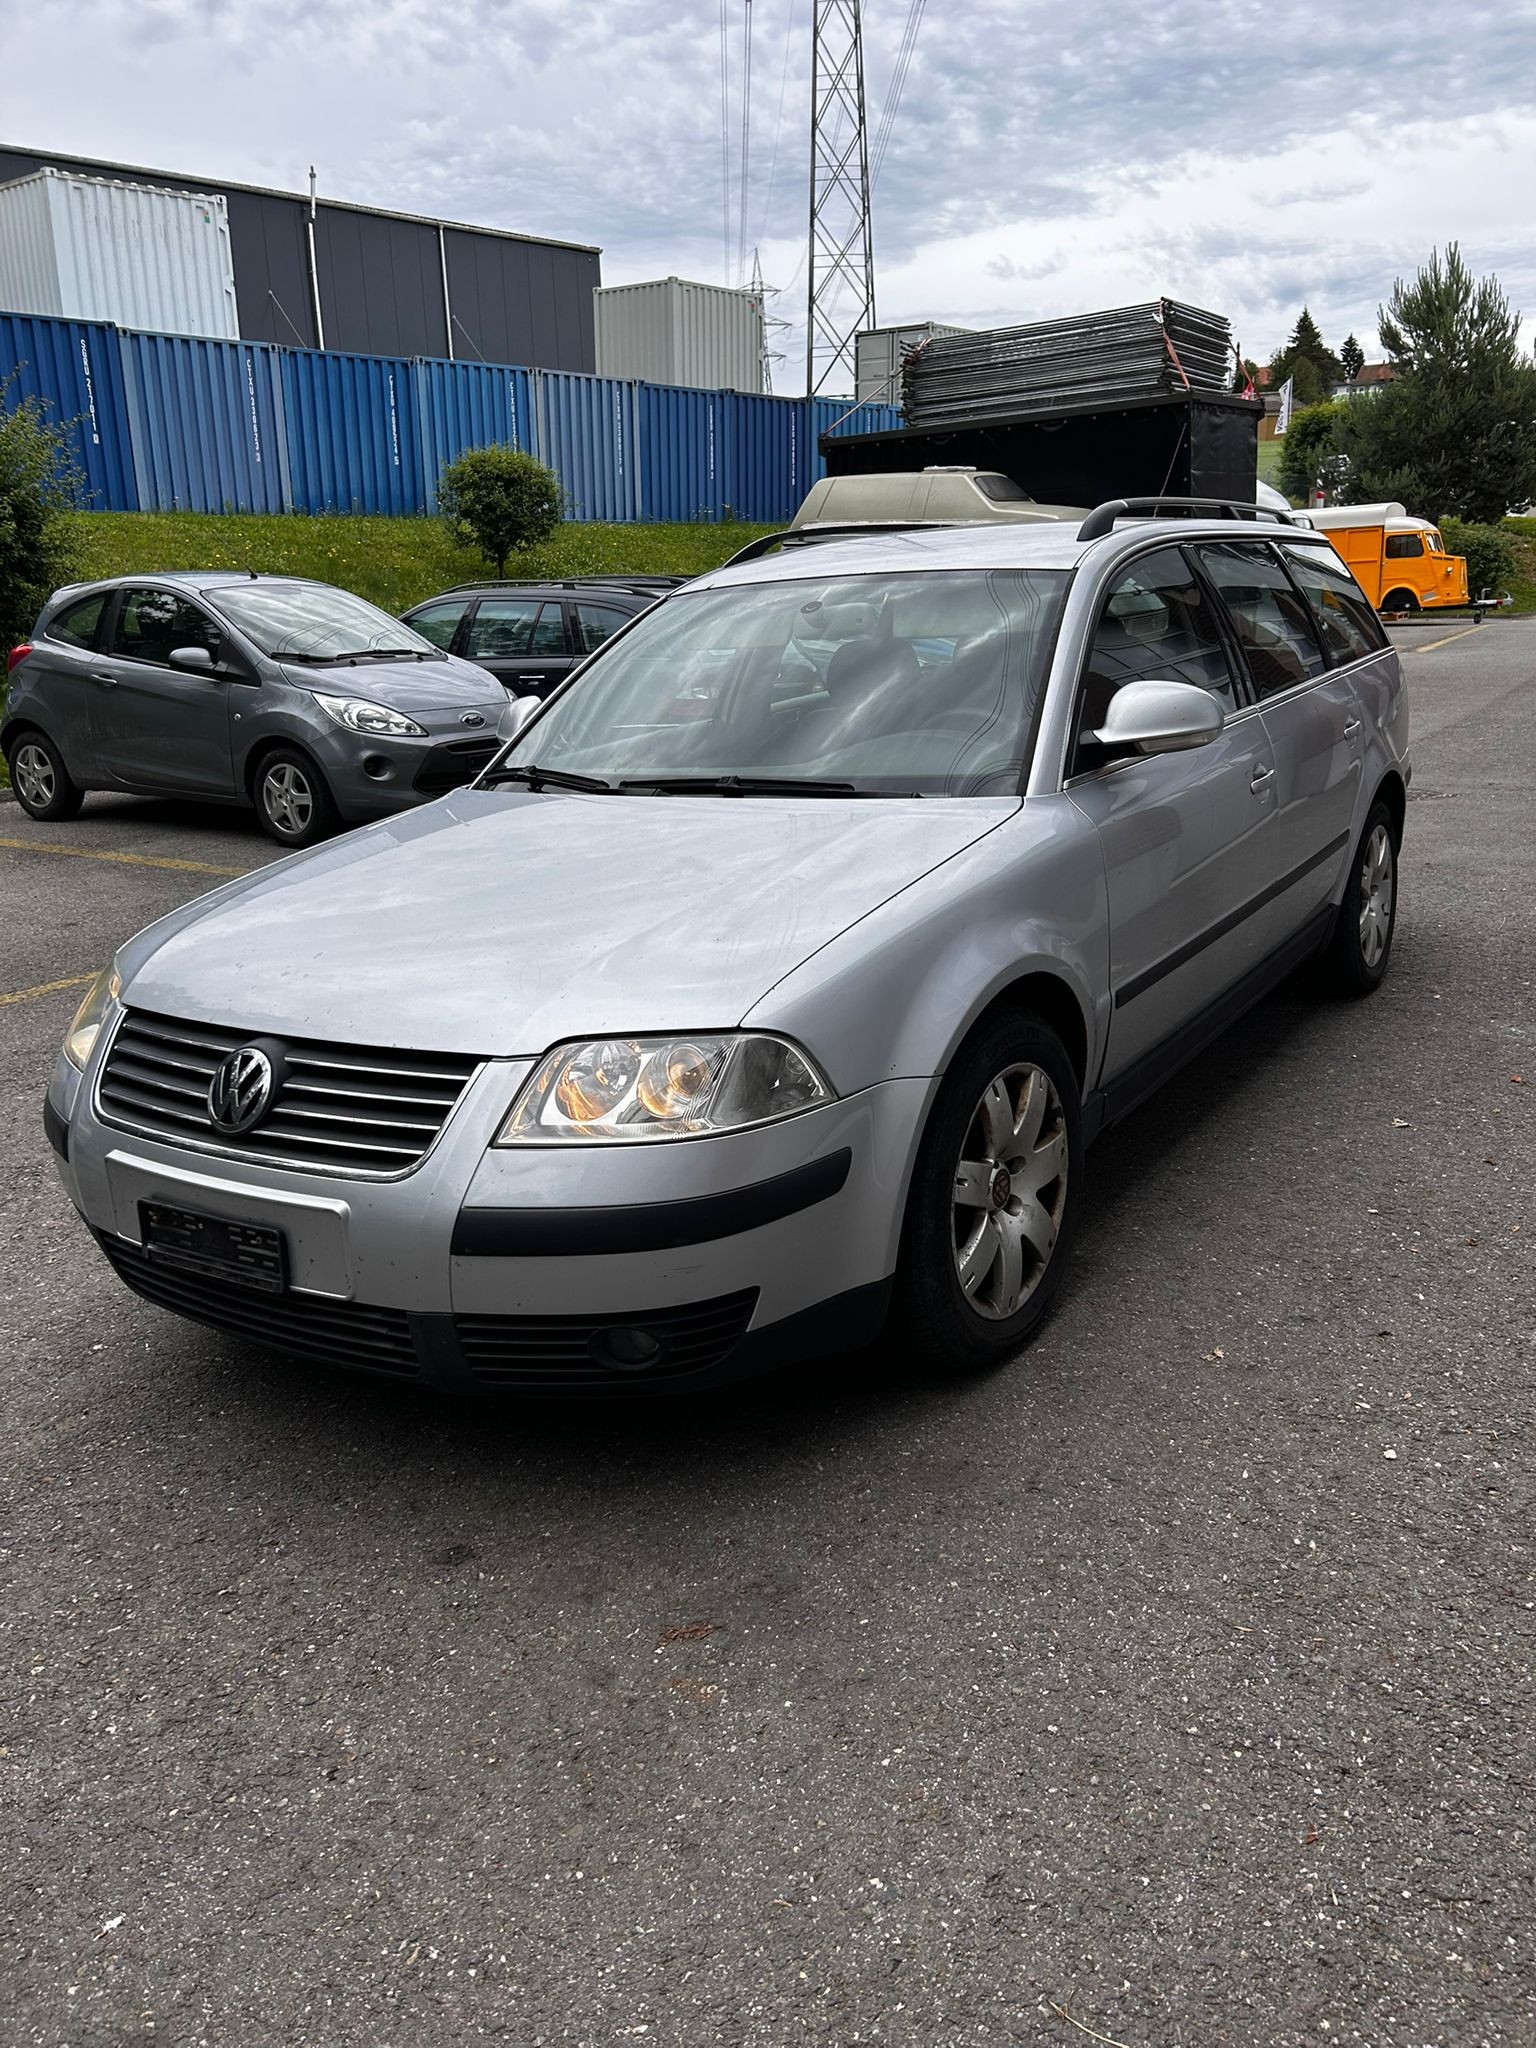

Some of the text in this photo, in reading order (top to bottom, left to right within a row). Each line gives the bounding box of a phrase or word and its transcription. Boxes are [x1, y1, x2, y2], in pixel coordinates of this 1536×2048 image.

[246, 358, 254, 395] CTXU
[86, 377, 97, 431] 217011
[211, 1049, 271, 1131] VW
